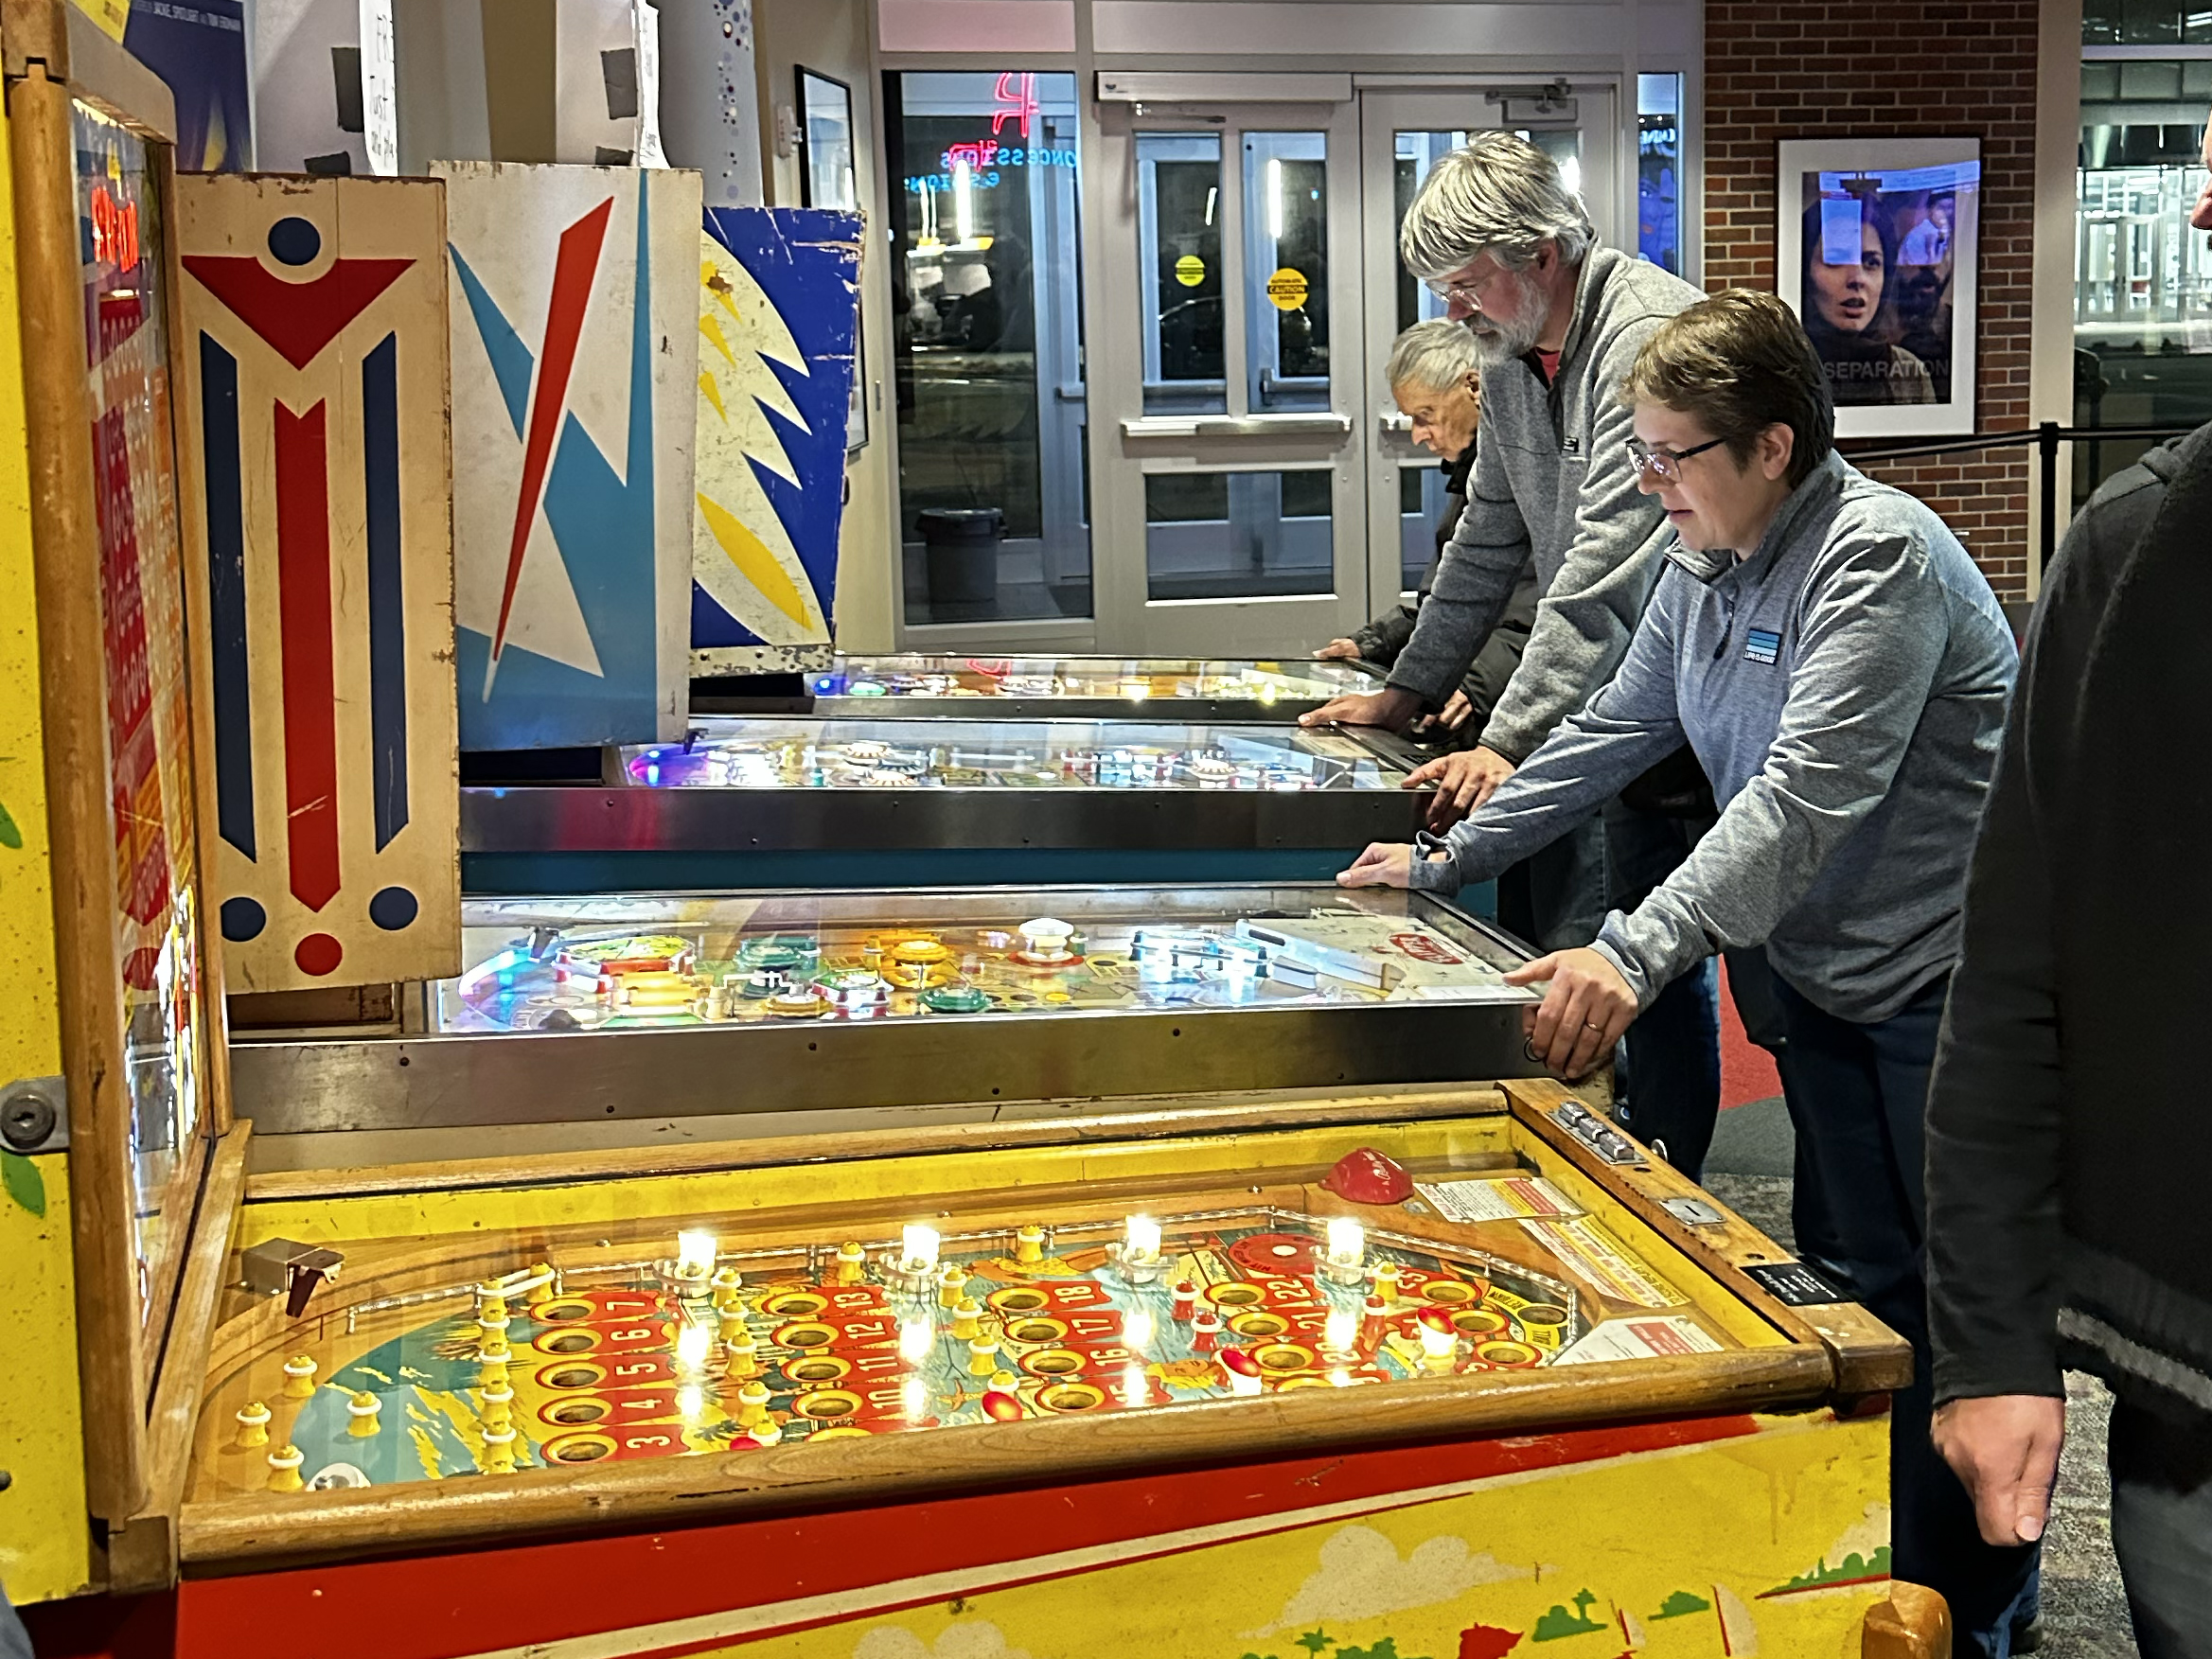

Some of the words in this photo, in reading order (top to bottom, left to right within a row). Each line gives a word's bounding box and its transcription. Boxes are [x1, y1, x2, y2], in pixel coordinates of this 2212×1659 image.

[1268, 286, 1305, 294] CAUTION
[1823, 359, 1950, 379] SEPARATION
[1054, 1285, 1095, 1304] 18
[1266, 1279, 1312, 1300] 22
[606, 1301, 646, 1311] 7
[833, 1292, 874, 1309] 13
[1071, 1318, 1114, 1335] 17
[1290, 1312, 1327, 1330] 21
[611, 1328, 651, 1341] 6
[844, 1321, 887, 1339] 12
[856, 1355, 898, 1371] 11
[1089, 1349, 1133, 1367] 16
[615, 1362, 658, 1376] 5
[620, 1399, 664, 1409] 4
[867, 1388, 908, 1409] 10
[626, 1435, 671, 1449] 3
